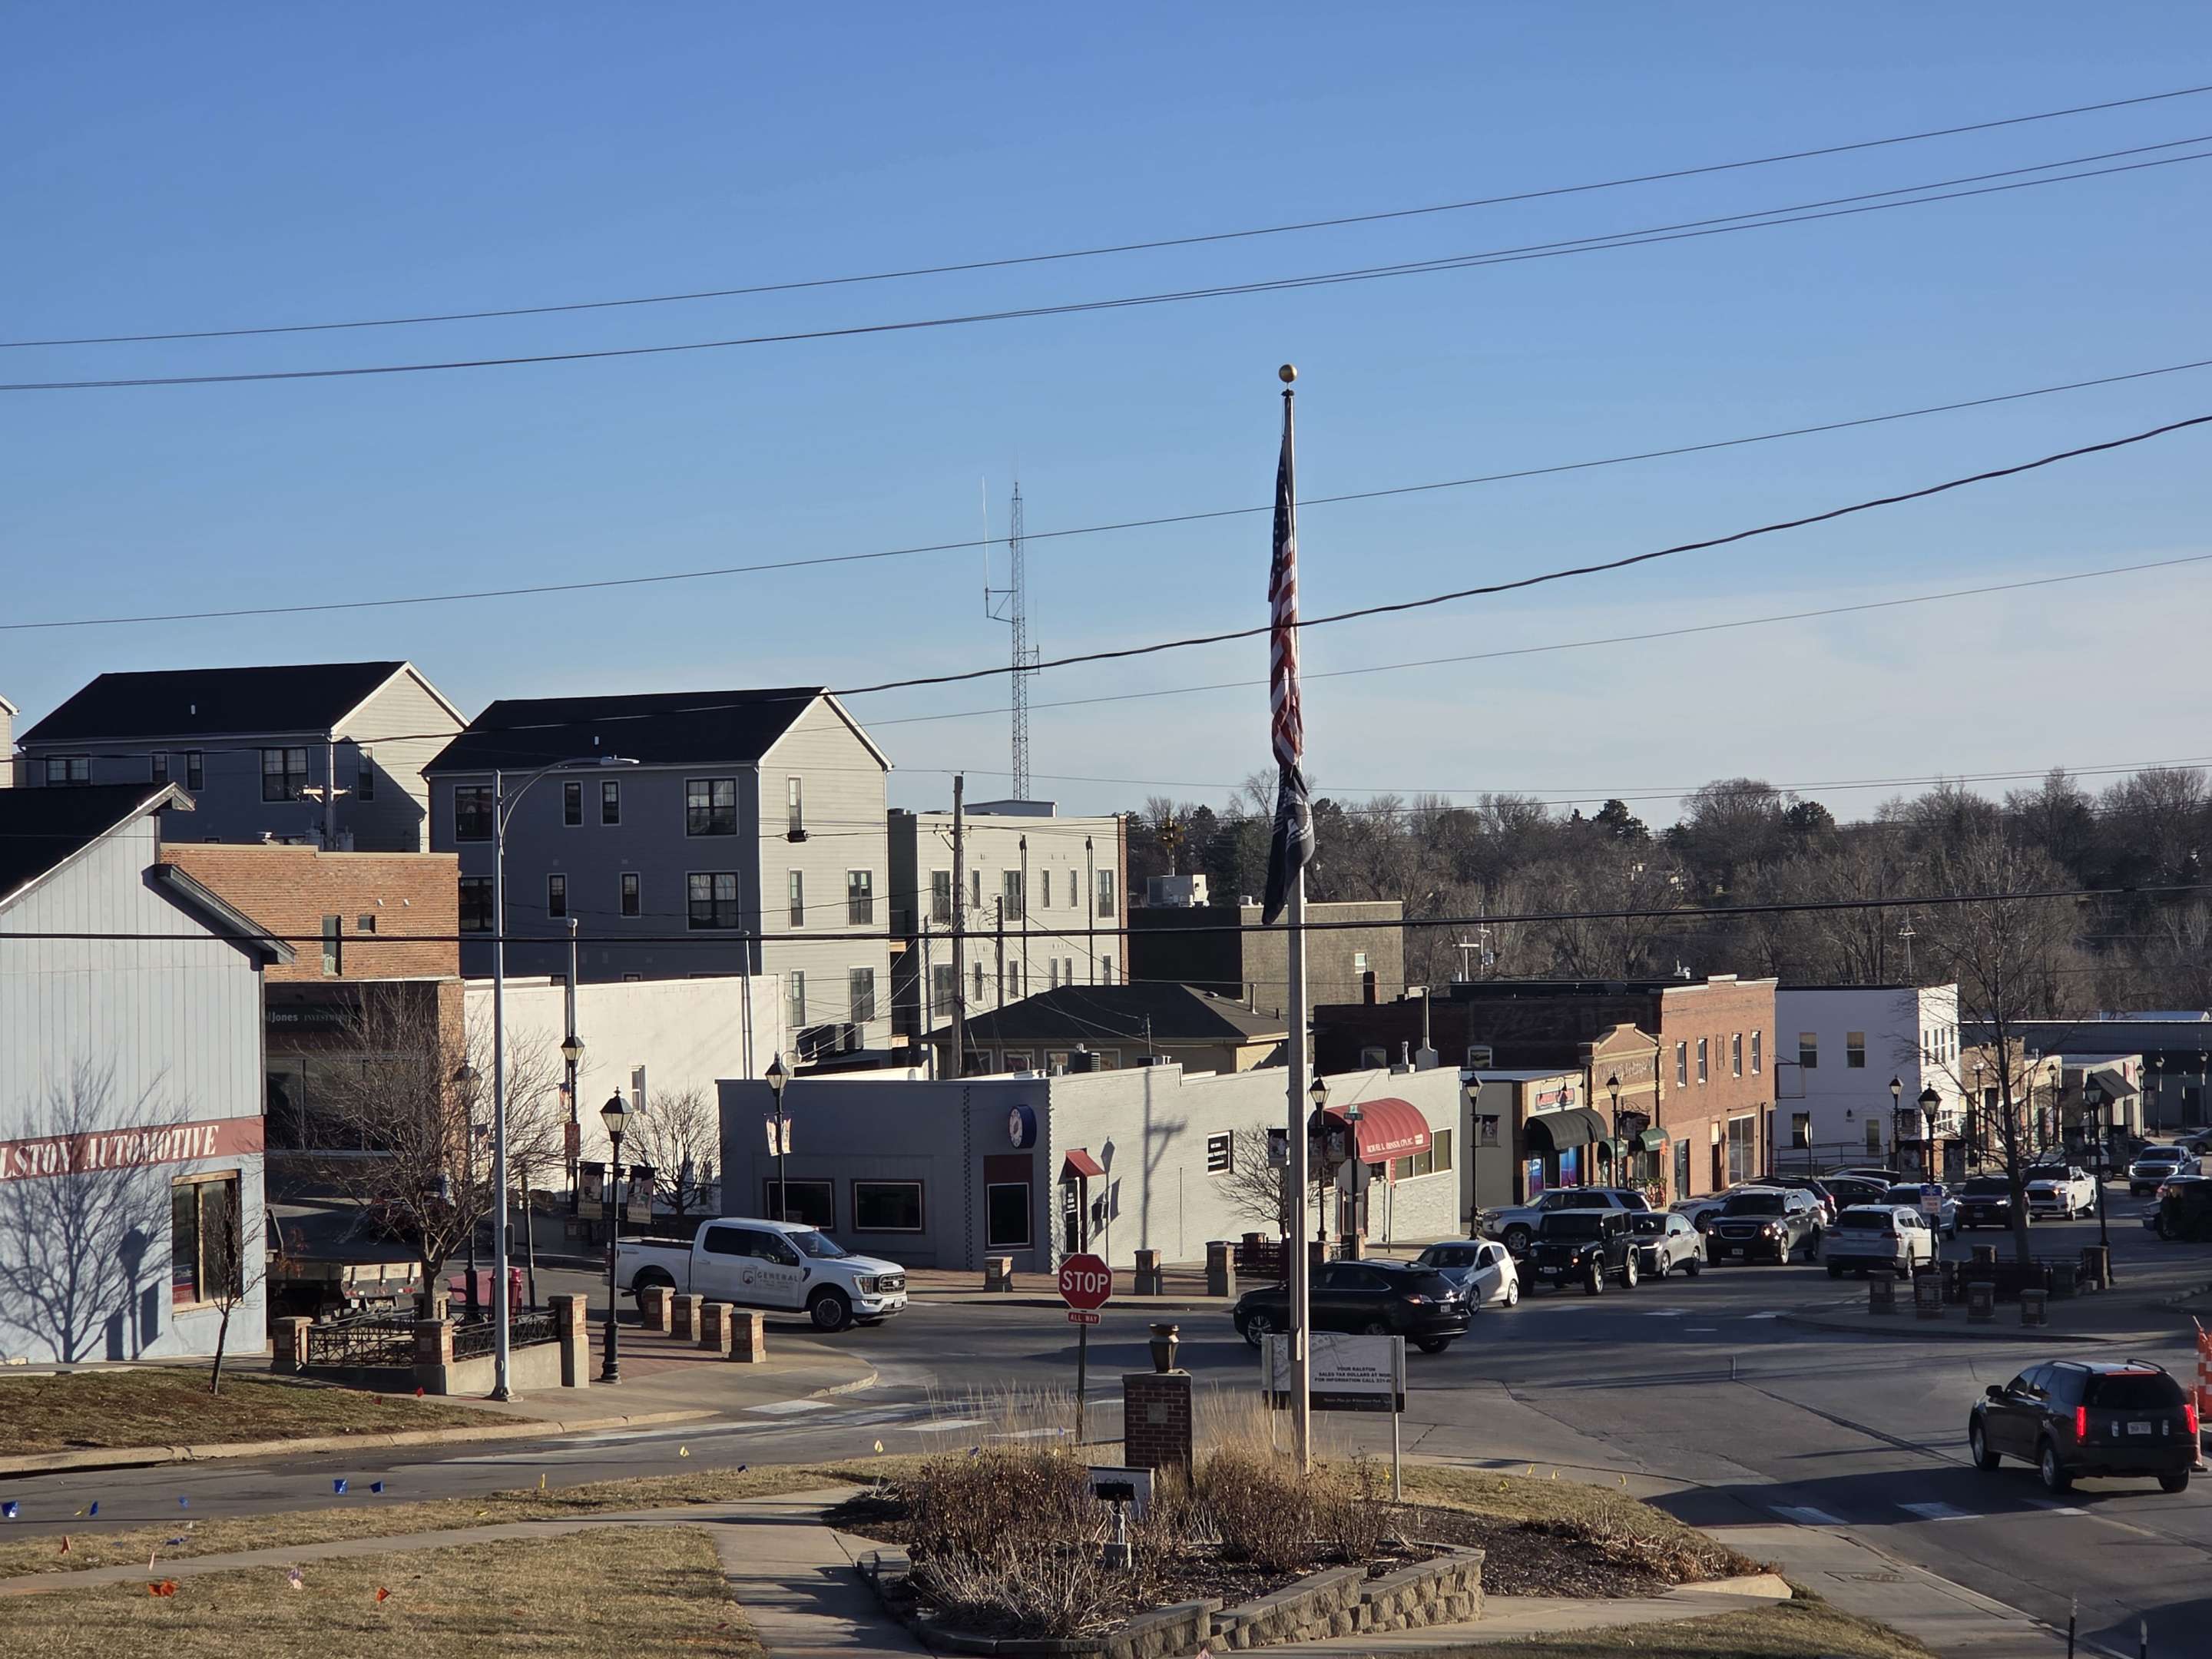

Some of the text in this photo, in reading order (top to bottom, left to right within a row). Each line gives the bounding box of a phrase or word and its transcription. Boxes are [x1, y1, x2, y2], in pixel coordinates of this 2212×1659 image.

[83, 1124, 220, 1171] AUTOMOTIVE
[1061, 1270, 1108, 1293] STOP
[1069, 1313, 1098, 1323] ALL WAY
